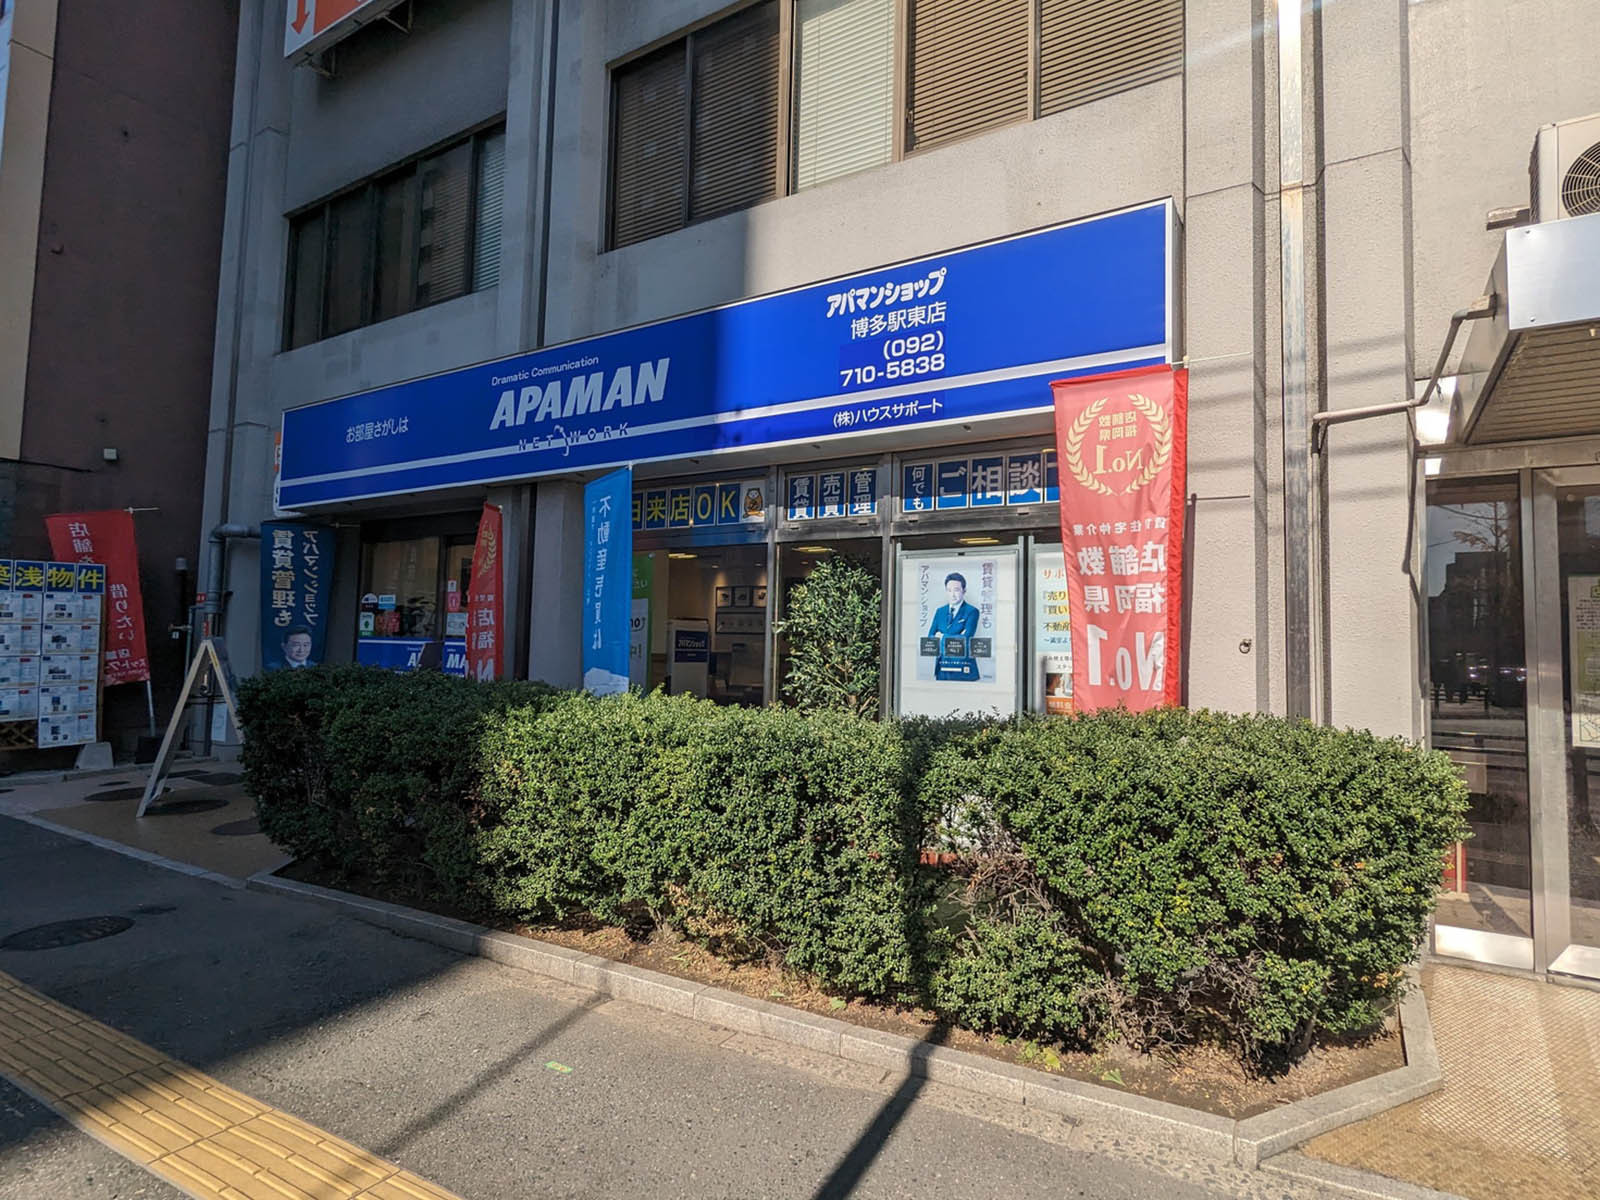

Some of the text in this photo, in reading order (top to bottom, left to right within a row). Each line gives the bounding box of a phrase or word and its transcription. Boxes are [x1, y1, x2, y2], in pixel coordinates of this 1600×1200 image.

[826, 267, 947, 318] アパマンショップ
[851, 301, 947, 340] 博多駅東店
[883, 331, 944, 360] (092)
[491, 356, 599, 386] Dramatic Communication
[840, 353, 945, 387] 710-5838
[489, 357, 670, 431] APAMAN
[833, 398, 943, 428] (株)ハウスサポート
[346, 416, 409, 444] お部屋さがしは
[852, 471, 873, 515] 管理
[911, 465, 926, 511] 何でも
[939, 460, 1058, 500] ご相談
